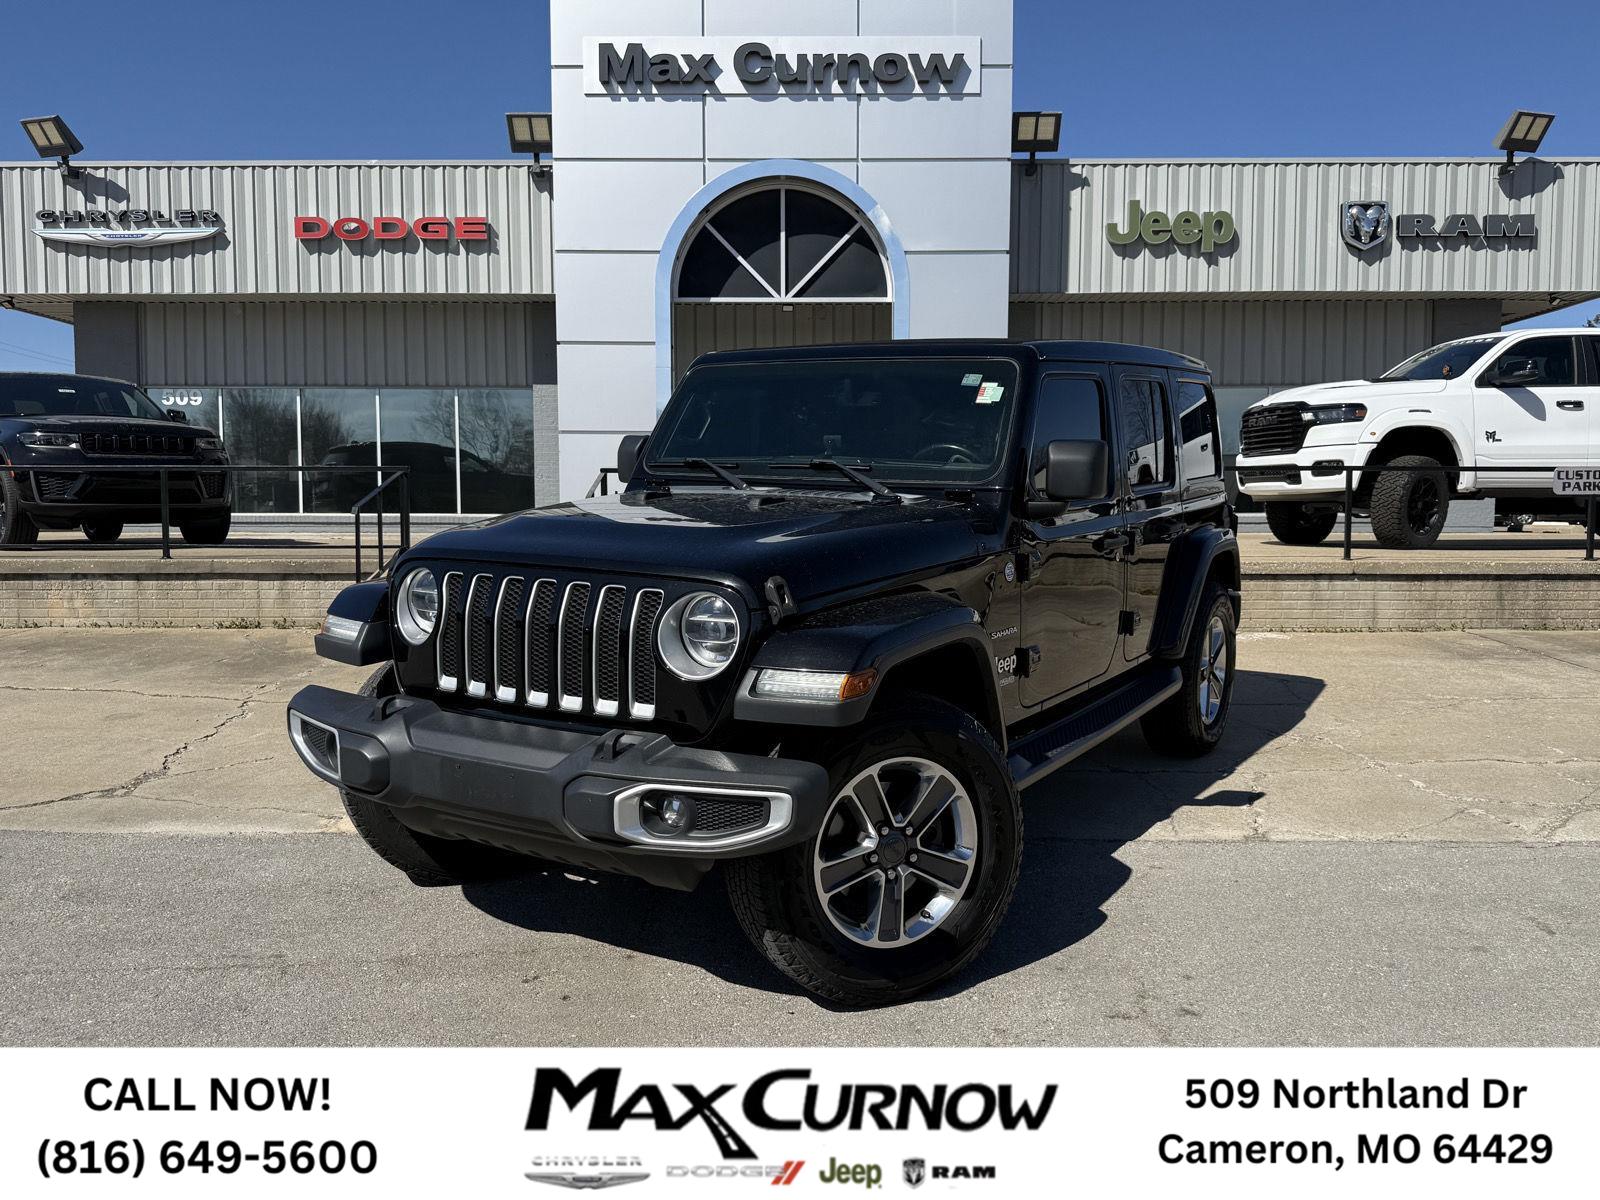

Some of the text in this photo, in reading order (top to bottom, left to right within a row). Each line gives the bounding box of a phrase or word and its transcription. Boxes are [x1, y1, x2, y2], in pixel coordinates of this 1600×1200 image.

[599, 42, 965, 84] Max Curnow
[36, 209, 217, 222] CHRYSLER
[1105, 199, 1235, 252] Jeep
[1400, 213, 1536, 238] RAM
[294, 216, 488, 241] DODGE
[161, 389, 203, 406] 509
[991, 626, 1018, 640] SAHARA
